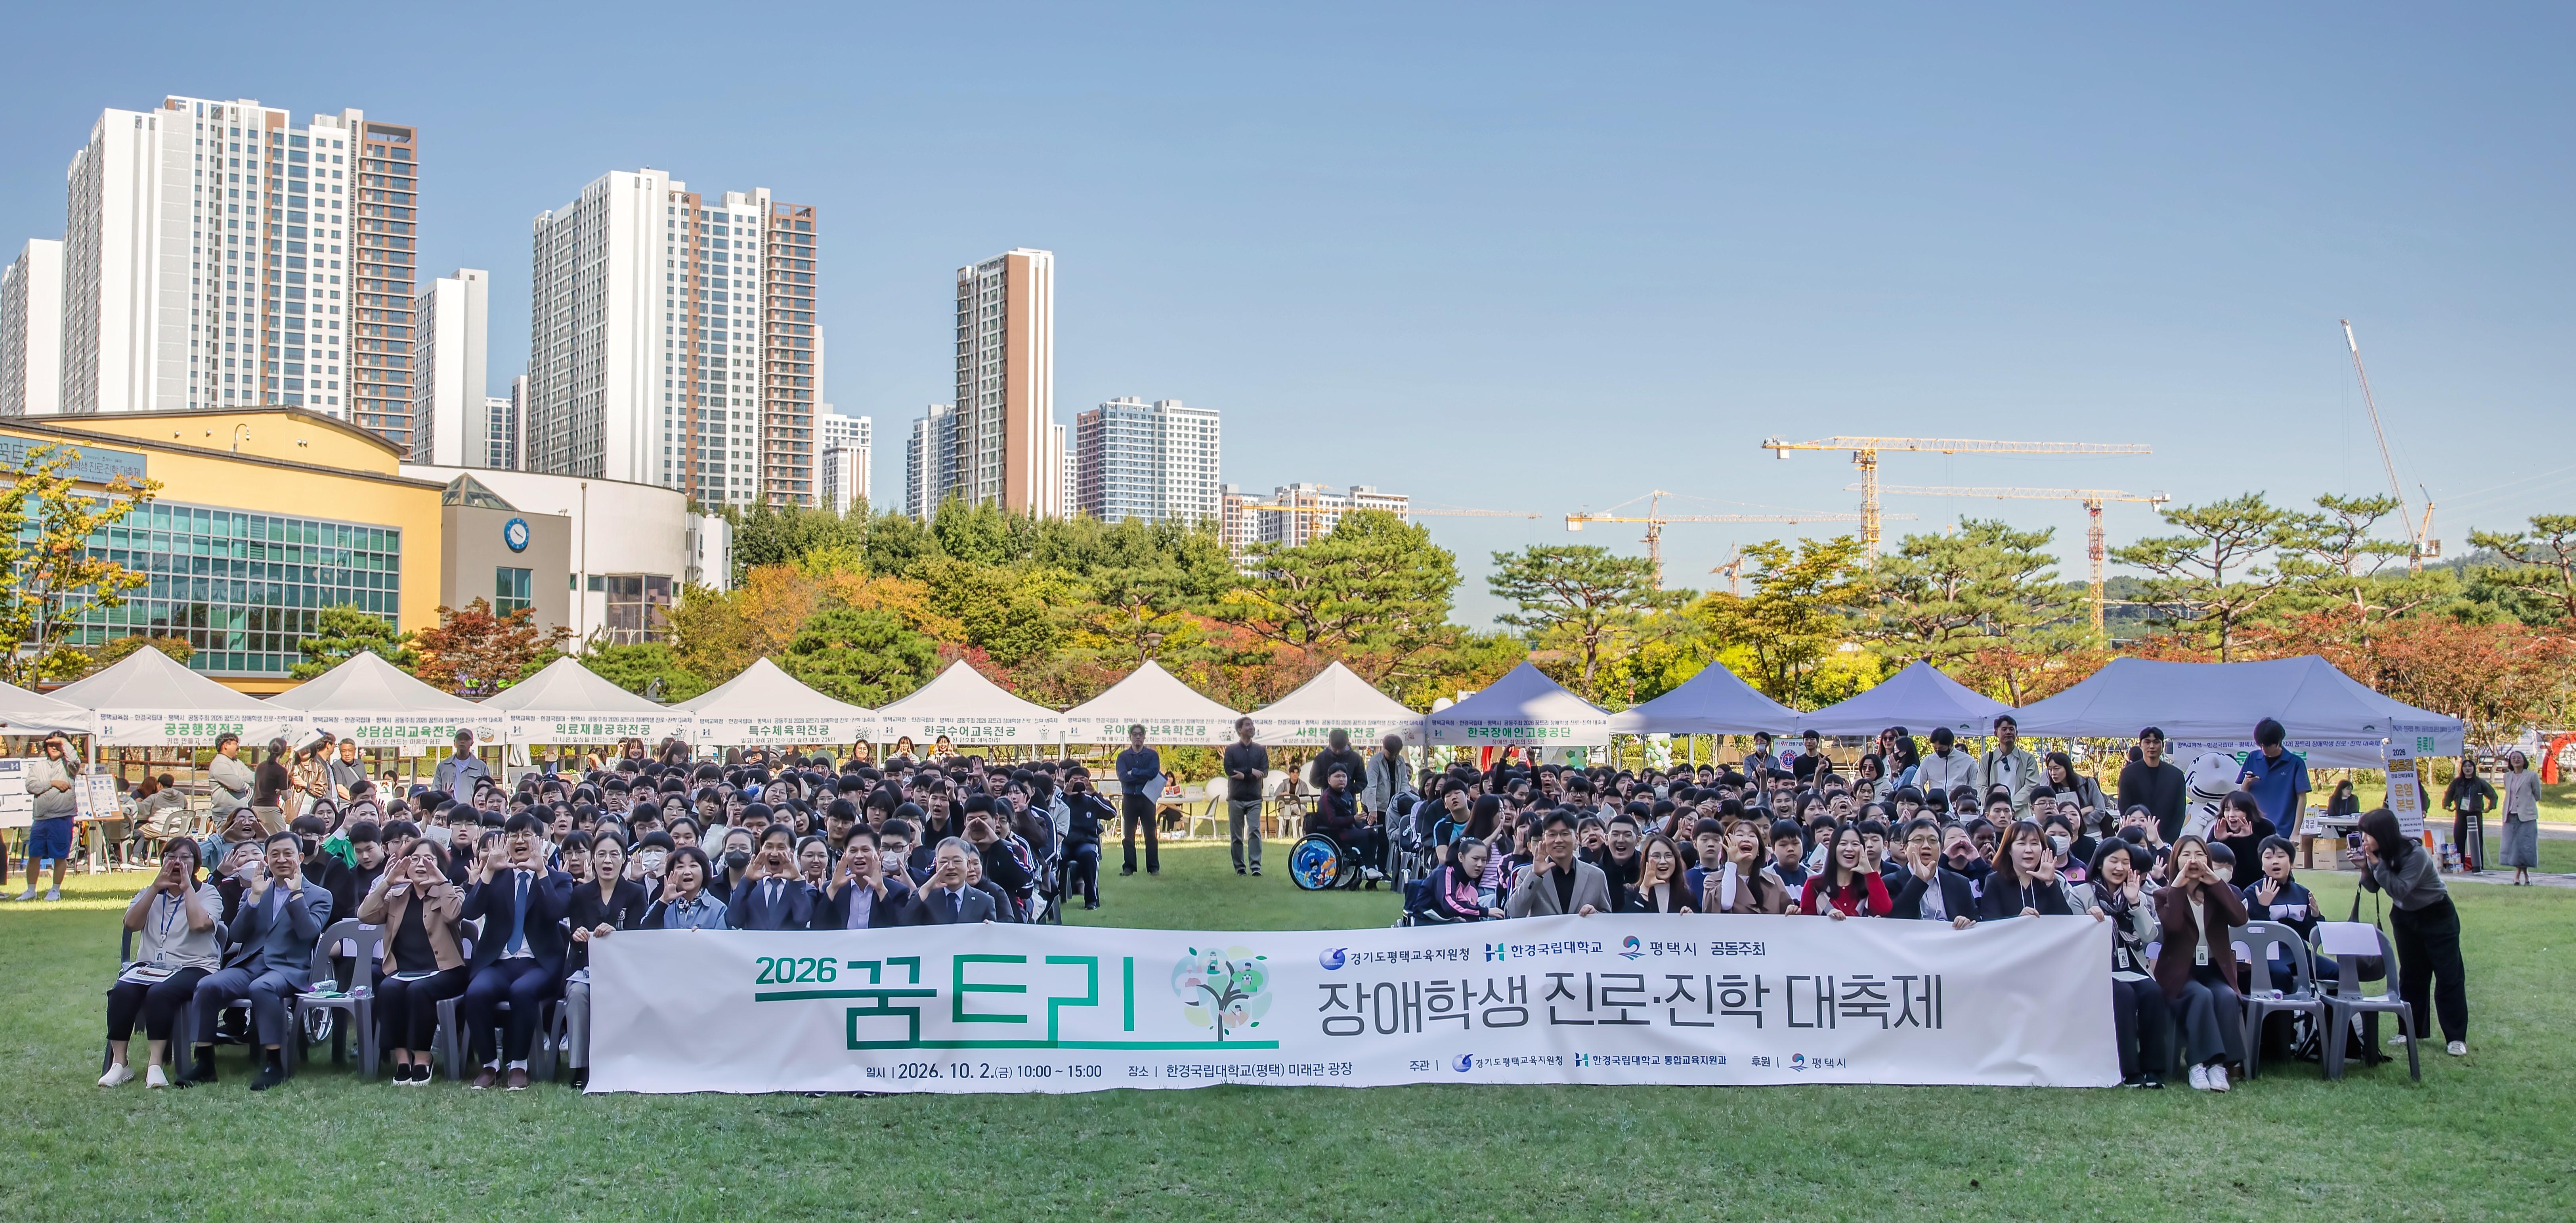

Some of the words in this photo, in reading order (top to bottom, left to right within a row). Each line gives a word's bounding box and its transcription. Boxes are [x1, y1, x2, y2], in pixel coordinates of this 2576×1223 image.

[68, 459, 88, 472] 애학생
[89, 461, 119, 475] 진로·진학
[164, 723, 244, 736] 공공행정전공
[356, 726, 456, 738] 상담심리교육전공
[556, 723, 650, 735] 의료재활공학전공
[749, 725, 829, 736] 특수체육학전공
[924, 725, 1016, 737] 한국수어교육전공
[1104, 724, 1206, 735] 유아보육학전공
[1468, 727, 1571, 738] 한국장애인고용공단
[2416, 737, 2435, 753] 등록대
[2388, 759, 2414, 773] 꿈트리
[2394, 783, 2414, 798] 운영
[2396, 798, 2416, 813] 본부
[1350, 947, 1469, 965] 경기도평택교육지원청
[1511, 941, 1603, 958] 한경국립대학교
[1650, 942, 1696, 956] 평택시
[1711, 942, 1766, 956] 공동주최
[755, 957, 837, 985] 2026
[844, 954, 1135, 1050] 꿈트리
[1318, 975, 1529, 1036] 장애학생
[1545, 972, 1770, 1029] 진로·진학
[1786, 974, 1942, 1030] 대축제
[866, 1067, 885, 1078] 일시
[898, 1062, 943, 1079] 2026.
[951, 1063, 974, 1079] 10.
[980, 1063, 1012, 1079] 2.(금)
[1018, 1065, 1051, 1078] 10:00
[1068, 1065, 1102, 1078] 15:00
[1128, 1066, 1148, 1077] 장소
[1166, 1063, 1284, 1079] 한경국립대학교(평택)
[1289, 1063, 1325, 1077] 미래관
[1328, 1062, 1353, 1076] 광장
[1410, 1060, 1430, 1072] 주관
[1474, 1055, 1563, 1068] 경기도평택교육지원청
[1592, 1055, 1661, 1066] 한경국립대학교
[1664, 1055, 1727, 1065] 통합교육지원과
[1751, 1056, 1771, 1067] 후원
[1812, 1058, 1846, 1069] 평택시
